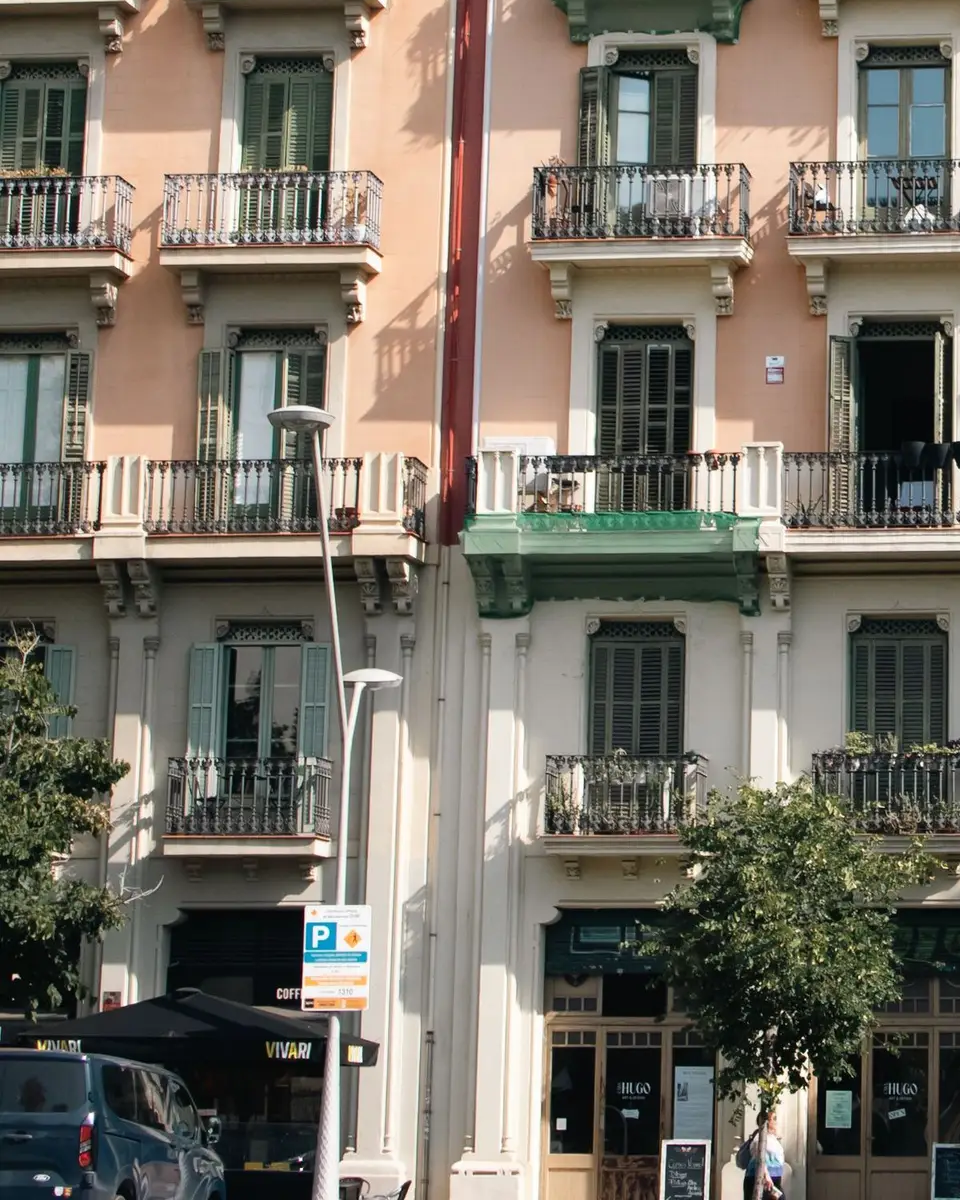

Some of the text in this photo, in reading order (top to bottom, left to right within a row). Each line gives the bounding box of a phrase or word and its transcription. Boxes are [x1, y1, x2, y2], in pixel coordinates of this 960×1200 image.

[312, 925, 330, 948] P
[276, 988, 303, 1000] COFF
[37, 1039, 82, 1052] VIVARI
[265, 1041, 312, 1060] VIVARI
[622, 1082, 651, 1095] HUGO
[888, 1082, 918, 1095] HUGO
